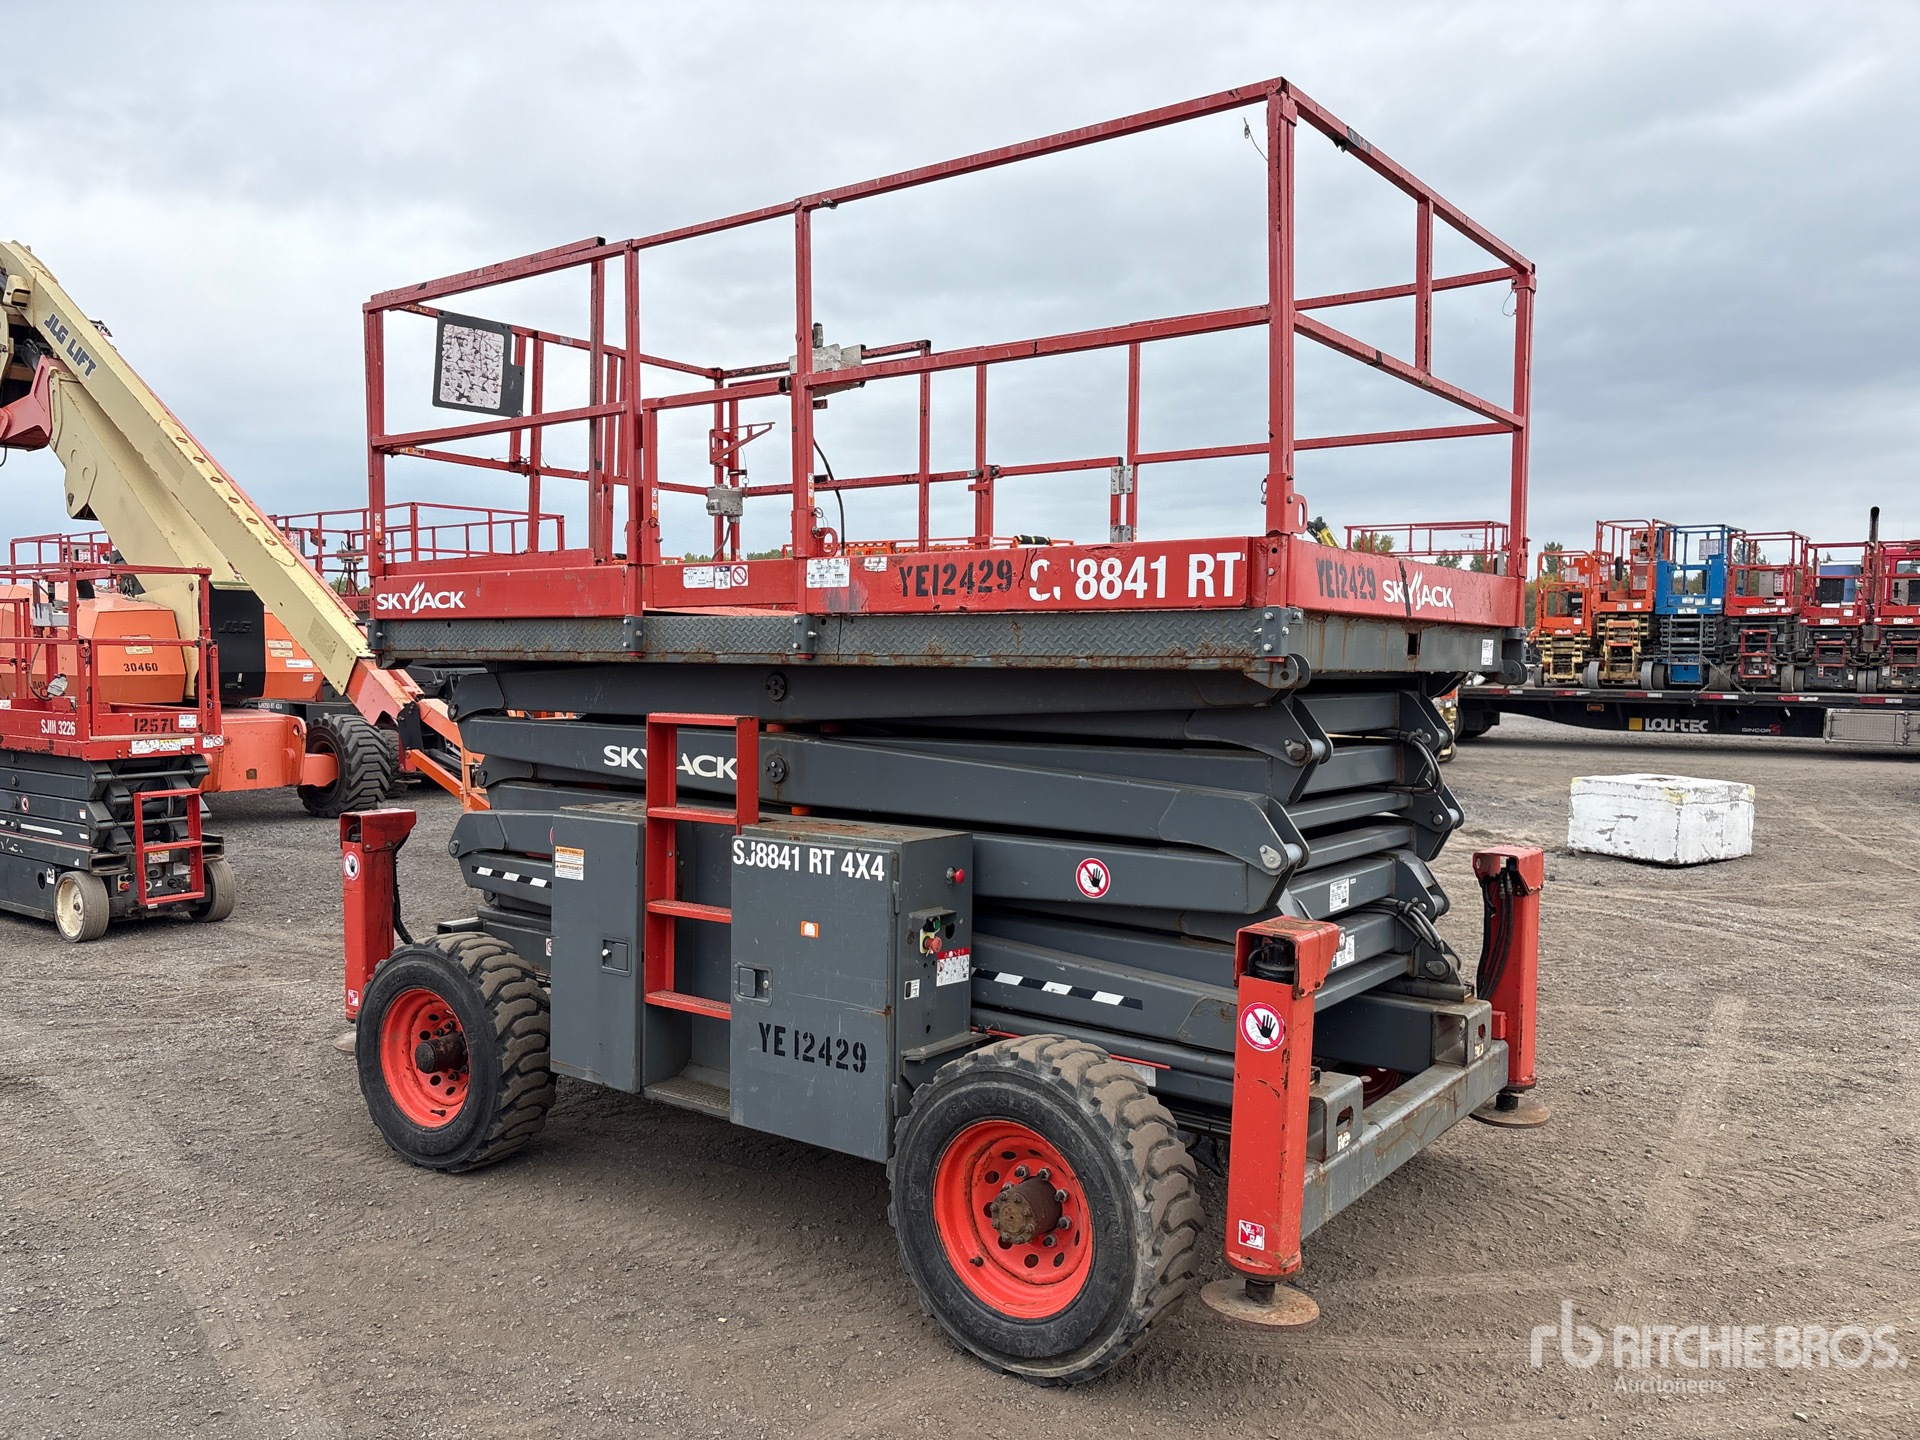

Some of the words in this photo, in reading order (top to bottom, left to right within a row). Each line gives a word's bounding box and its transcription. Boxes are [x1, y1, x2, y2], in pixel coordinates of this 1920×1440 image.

[43, 313, 69, 345] JLG
[66, 338, 97, 377] LIFT
[899, 559, 1014, 597] YE12429
[1029, 558, 1167, 601] S8841
[1188, 552, 1241, 598] RT
[1315, 558, 1376, 600] YE12429
[1382, 570, 1453, 611] SKYJACK
[376, 581, 466, 614] SKYJACK
[123, 662, 158, 673] 30460
[57, 720, 76, 736] 3226
[732, 840, 800, 872] SJ8841
[809, 847, 835, 875] RT
[841, 852, 885, 881] 4X4
[759, 1022, 786, 1057] YE
[794, 1030, 867, 1073] 12429
